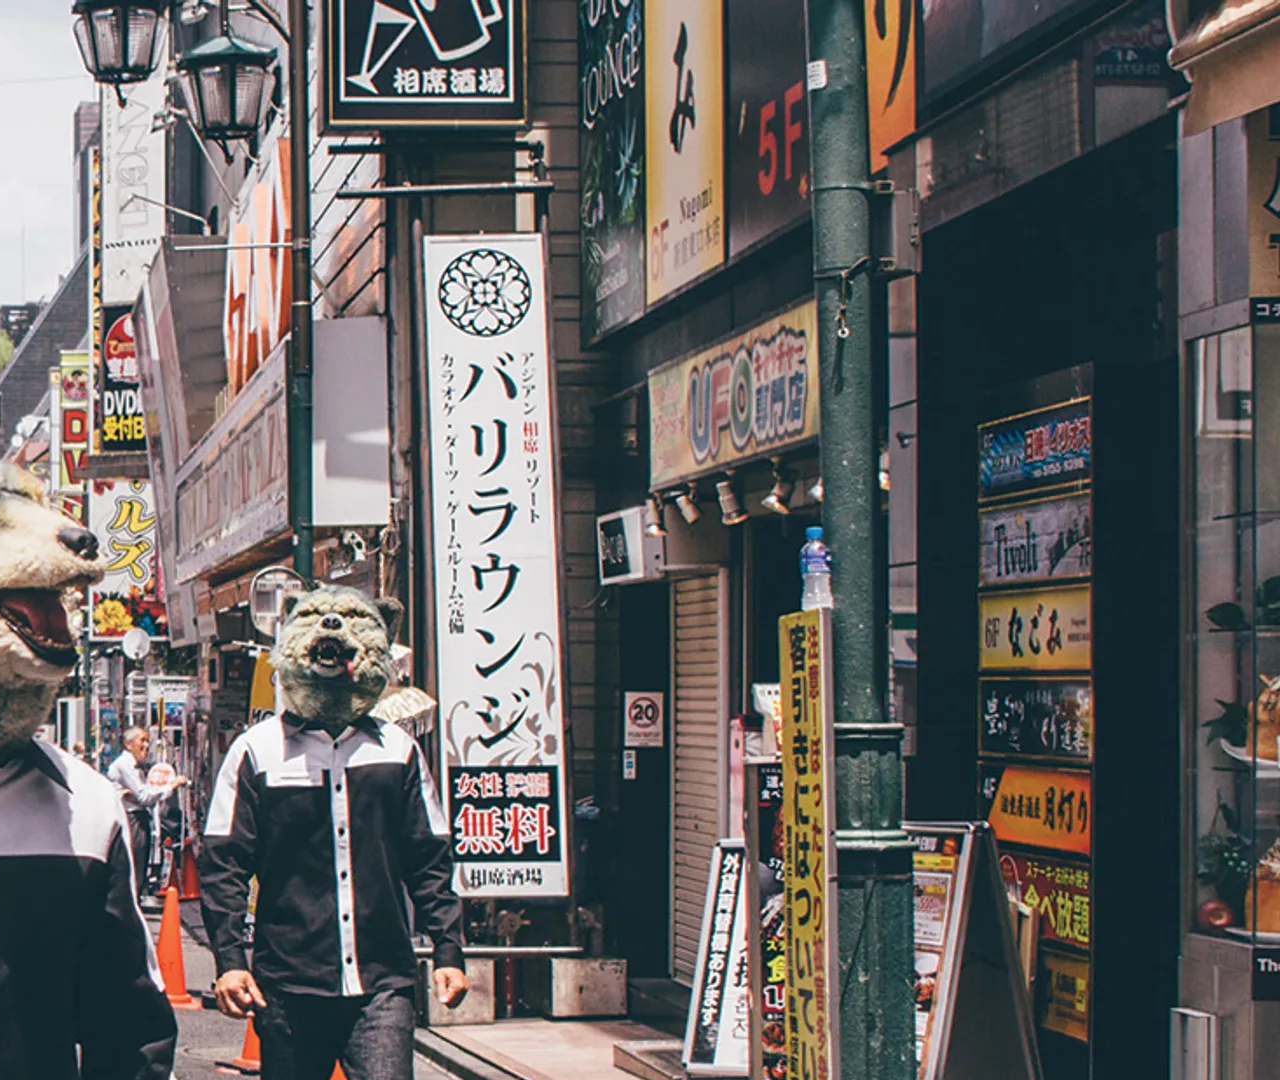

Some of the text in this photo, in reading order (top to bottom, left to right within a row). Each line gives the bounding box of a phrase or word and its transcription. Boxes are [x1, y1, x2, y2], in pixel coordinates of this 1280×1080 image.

[393, 67, 507, 95] 相席酒場
[582, 23, 640, 131] LOUNGE
[757, 81, 804, 195] 5F
[689, 348, 754, 466] UFO
[107, 480, 156, 580] ルズ
[457, 350, 530, 752] バリラウンジ
[993, 519, 1038, 578] Tivoli
[984, 616, 1000, 649] 6F
[633, 703, 656, 721] 20
[454, 771, 504, 799] 女性
[1042, 786, 1090, 835] 月灯り
[453, 802, 557, 855] 無料
[1257, 957, 1280, 973] Th
